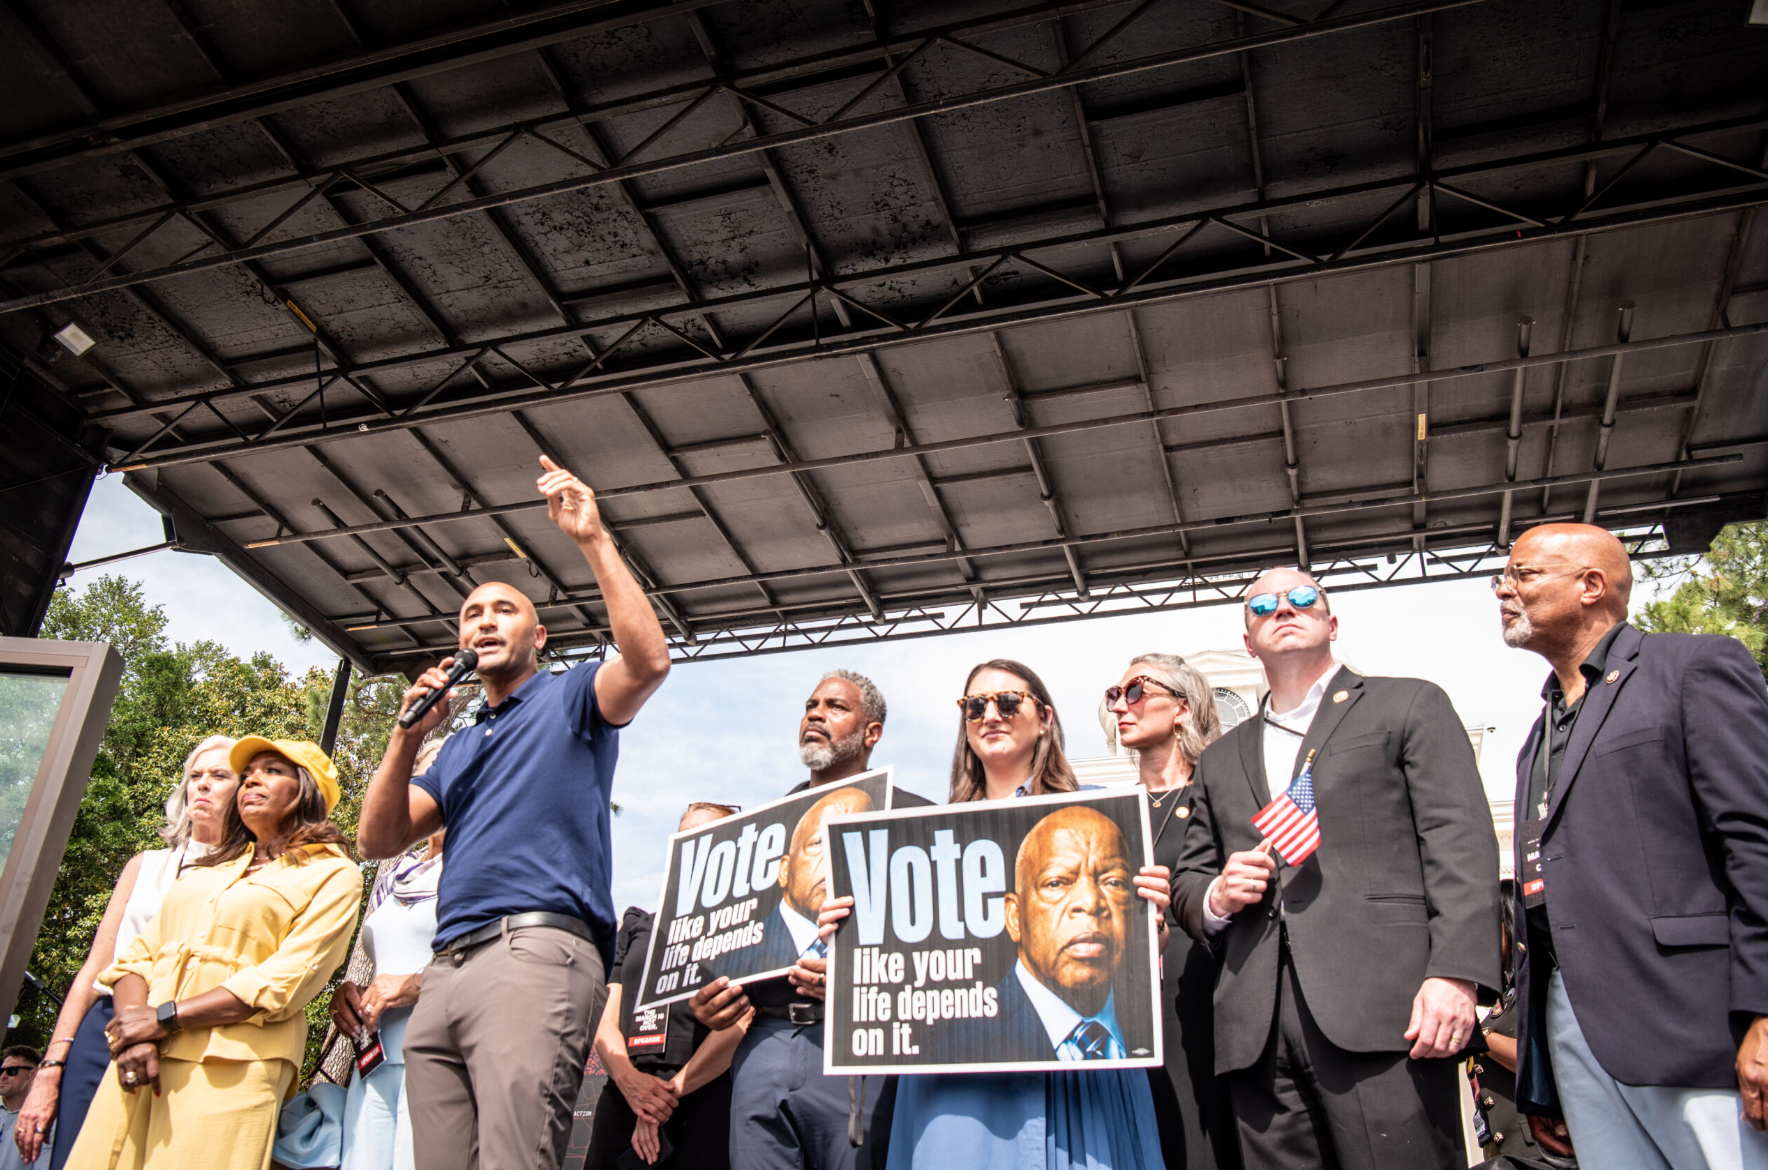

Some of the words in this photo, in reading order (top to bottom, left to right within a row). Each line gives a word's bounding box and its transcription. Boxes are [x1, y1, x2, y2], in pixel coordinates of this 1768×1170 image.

[675, 822, 787, 918] Vote
[842, 828, 1006, 945] Vote
[666, 915, 705, 946] like
[707, 897, 758, 937] your
[660, 942, 690, 972] life
[691, 920, 764, 961] depends
[853, 947, 905, 985] like
[912, 947, 982, 988] your
[655, 970, 680, 995] on
[682, 962, 702, 988] it.
[852, 986, 892, 1022] life
[897, 981, 998, 1025] depends
[633, 1036, 661, 1045] SPEAKER
[852, 1028, 884, 1056] on
[892, 1021, 920, 1055] it.
